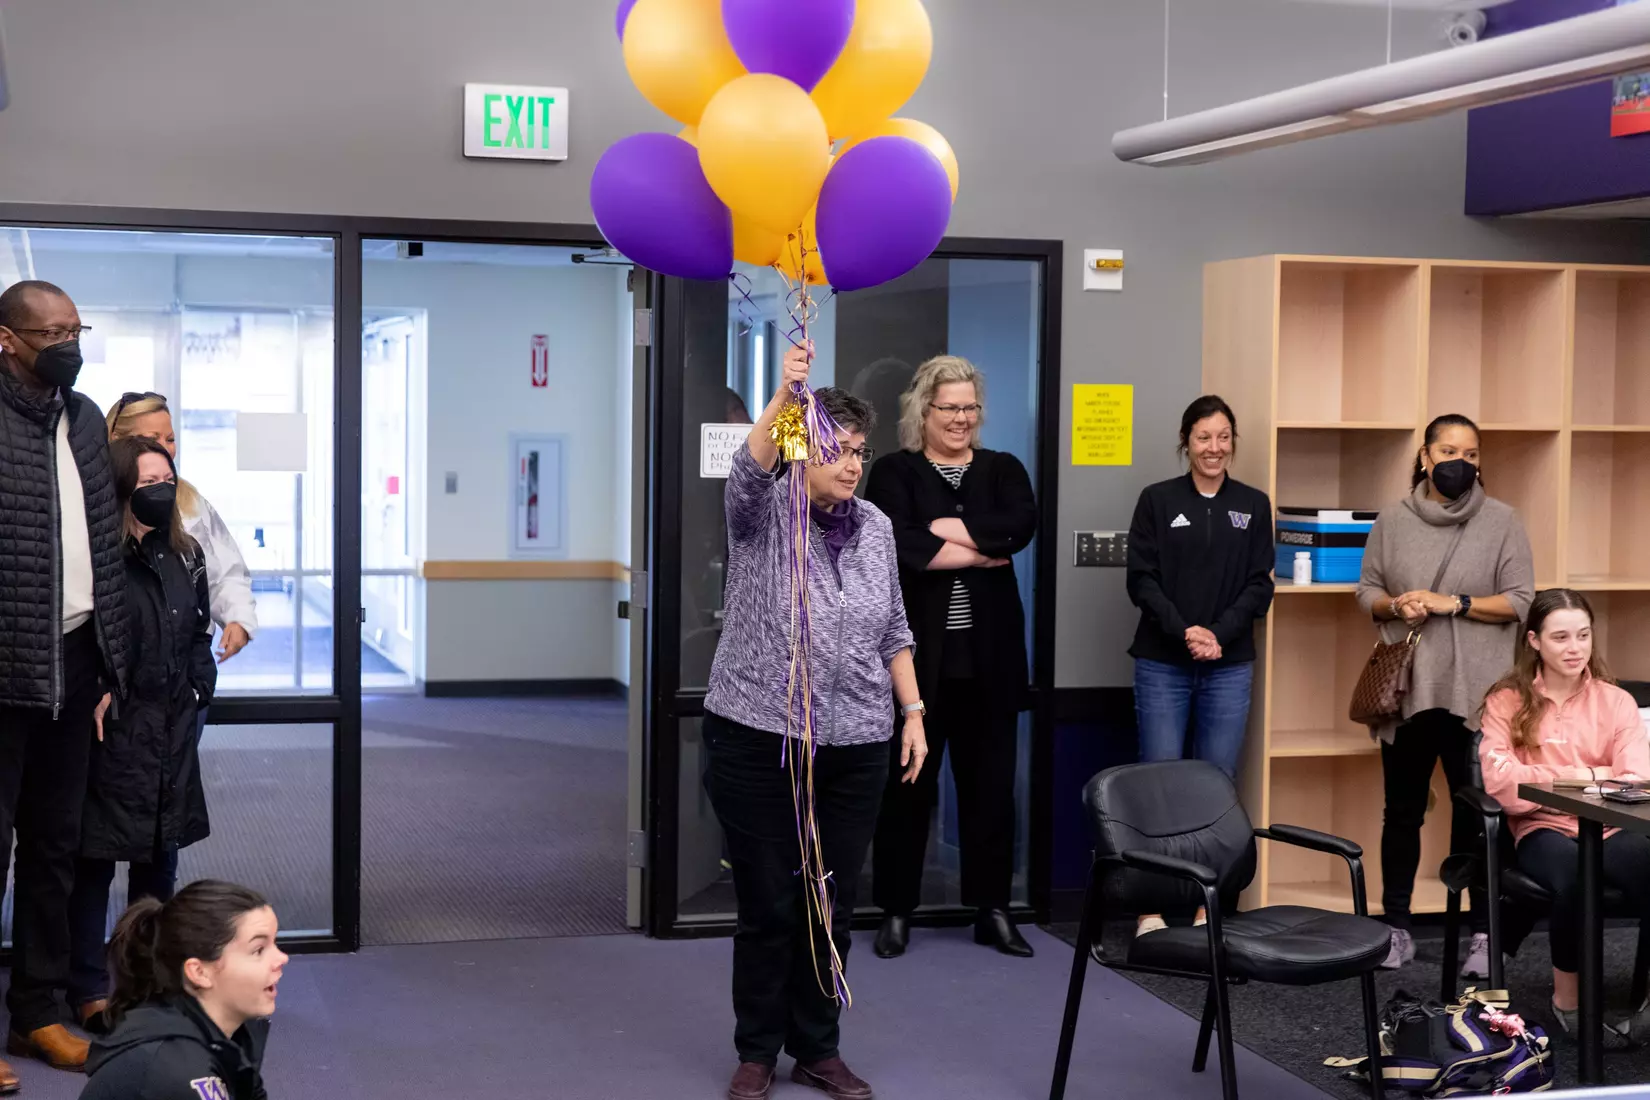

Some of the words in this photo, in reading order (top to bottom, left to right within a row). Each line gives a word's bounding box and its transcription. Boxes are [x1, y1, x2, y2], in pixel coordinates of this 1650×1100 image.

[483, 93, 555, 149] EXIT
[708, 431, 729, 441] NO
[710, 452, 731, 462] NO
[1228, 510, 1252, 530] W
